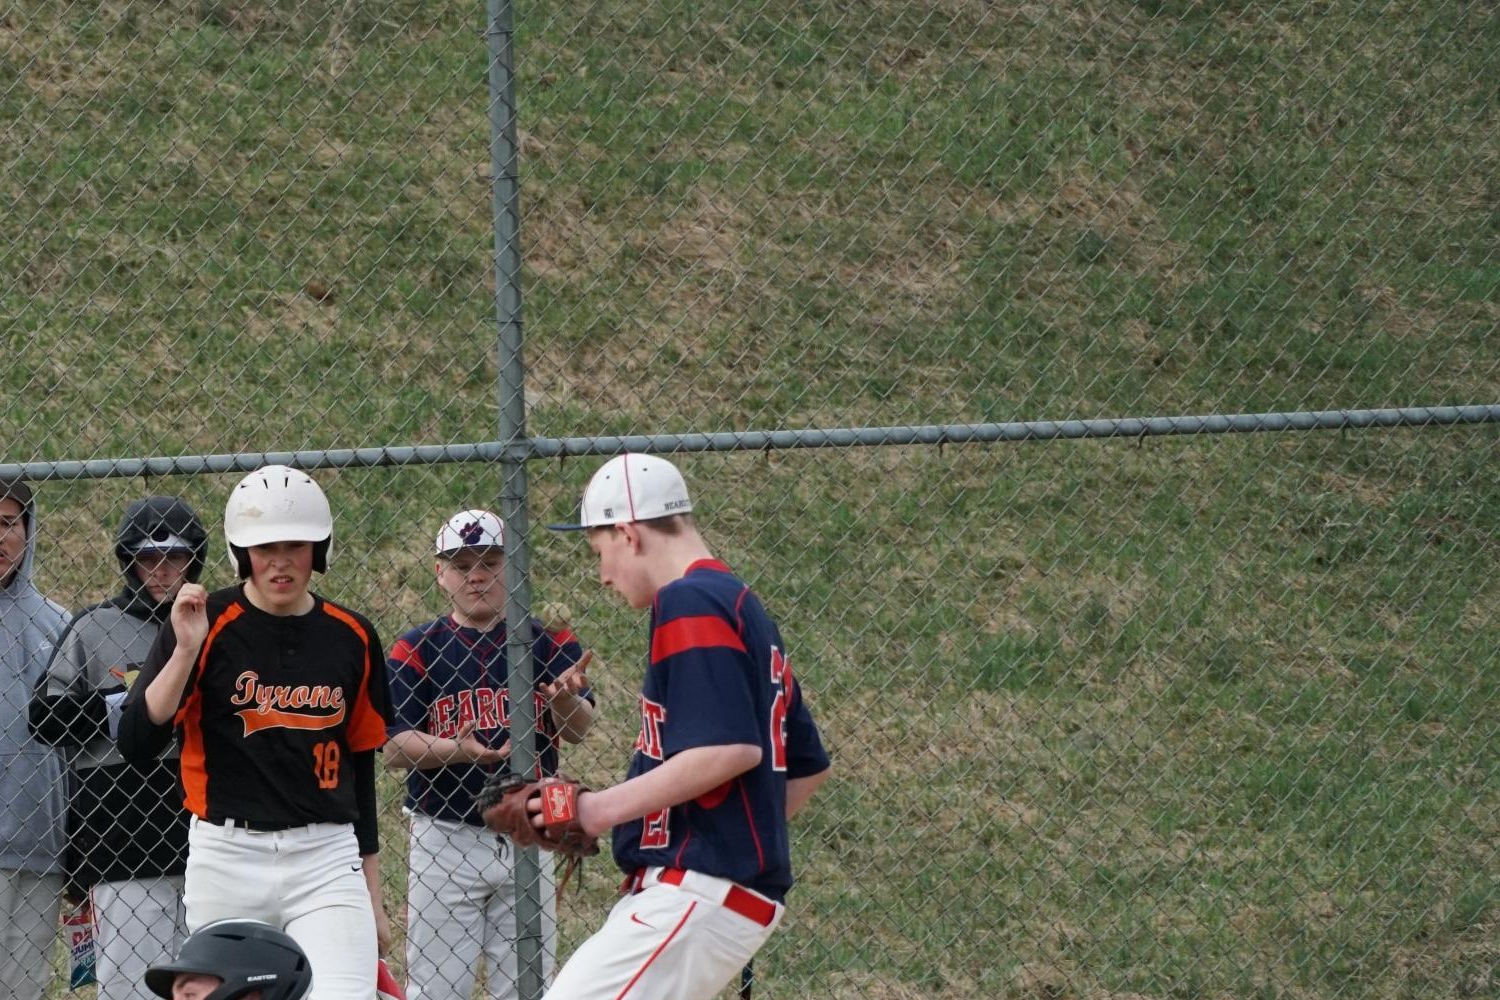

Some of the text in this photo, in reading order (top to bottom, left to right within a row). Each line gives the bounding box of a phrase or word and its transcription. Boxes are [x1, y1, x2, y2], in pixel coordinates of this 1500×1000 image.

[230, 670, 344, 716] Tyrone
[312, 740, 340, 789] 18
[247, 973, 277, 982] EASTON
